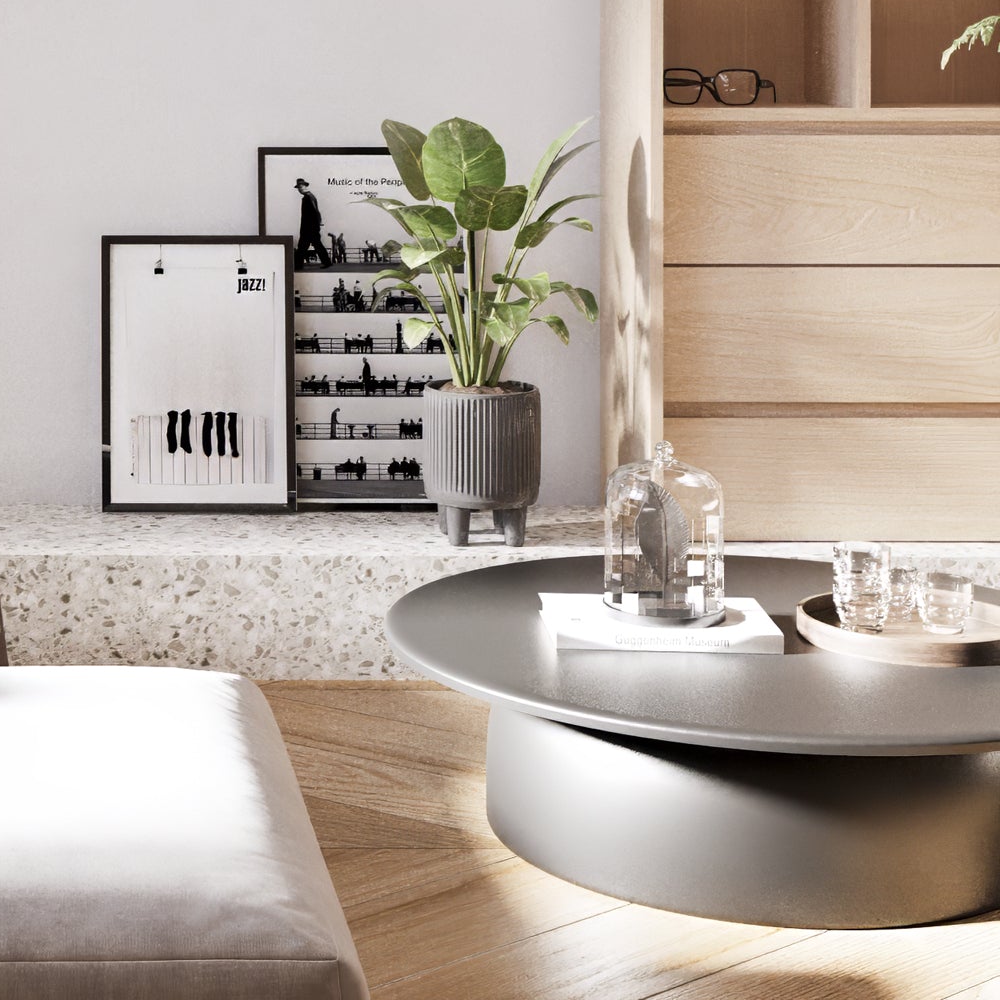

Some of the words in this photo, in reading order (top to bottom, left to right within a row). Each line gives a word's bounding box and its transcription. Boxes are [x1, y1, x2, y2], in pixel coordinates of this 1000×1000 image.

[327, 177, 353, 186] Music
[354, 178, 363, 186] of
[365, 178, 379, 186] the
[381, 177, 403, 187] Peop
[236, 278, 266, 294] jazz!
[615, 633, 682, 647] Guggenheim
[685, 635, 730, 648] Museum
